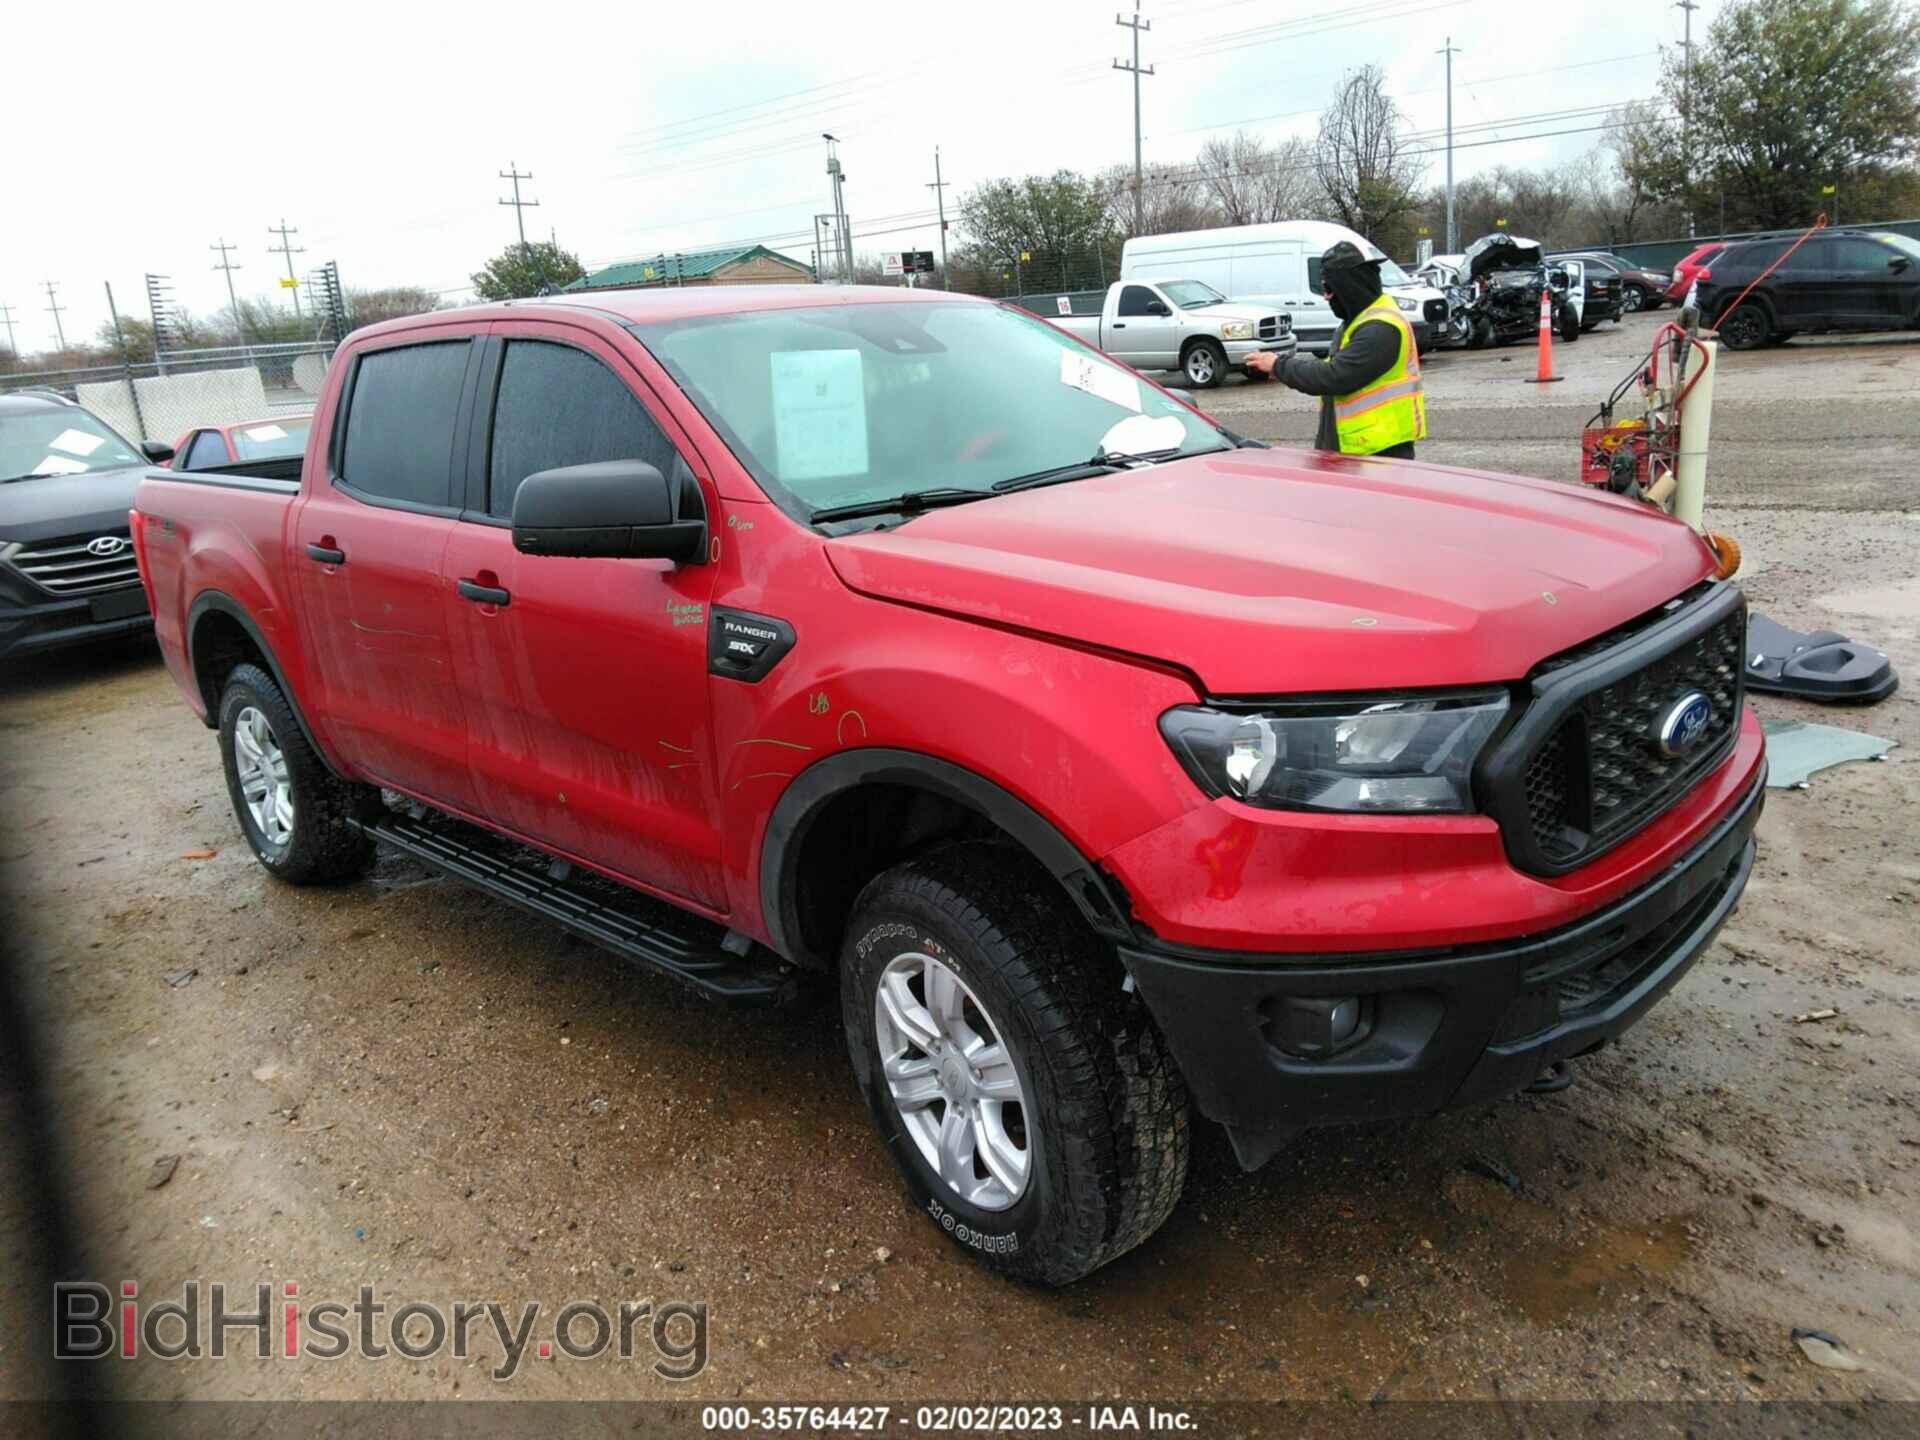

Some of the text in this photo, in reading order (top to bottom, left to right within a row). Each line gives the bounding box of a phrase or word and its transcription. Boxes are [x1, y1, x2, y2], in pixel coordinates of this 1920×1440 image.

[725, 622, 777, 641] RANGER
[728, 640, 755, 656] STX
[1680, 706, 1708, 745] Ford
